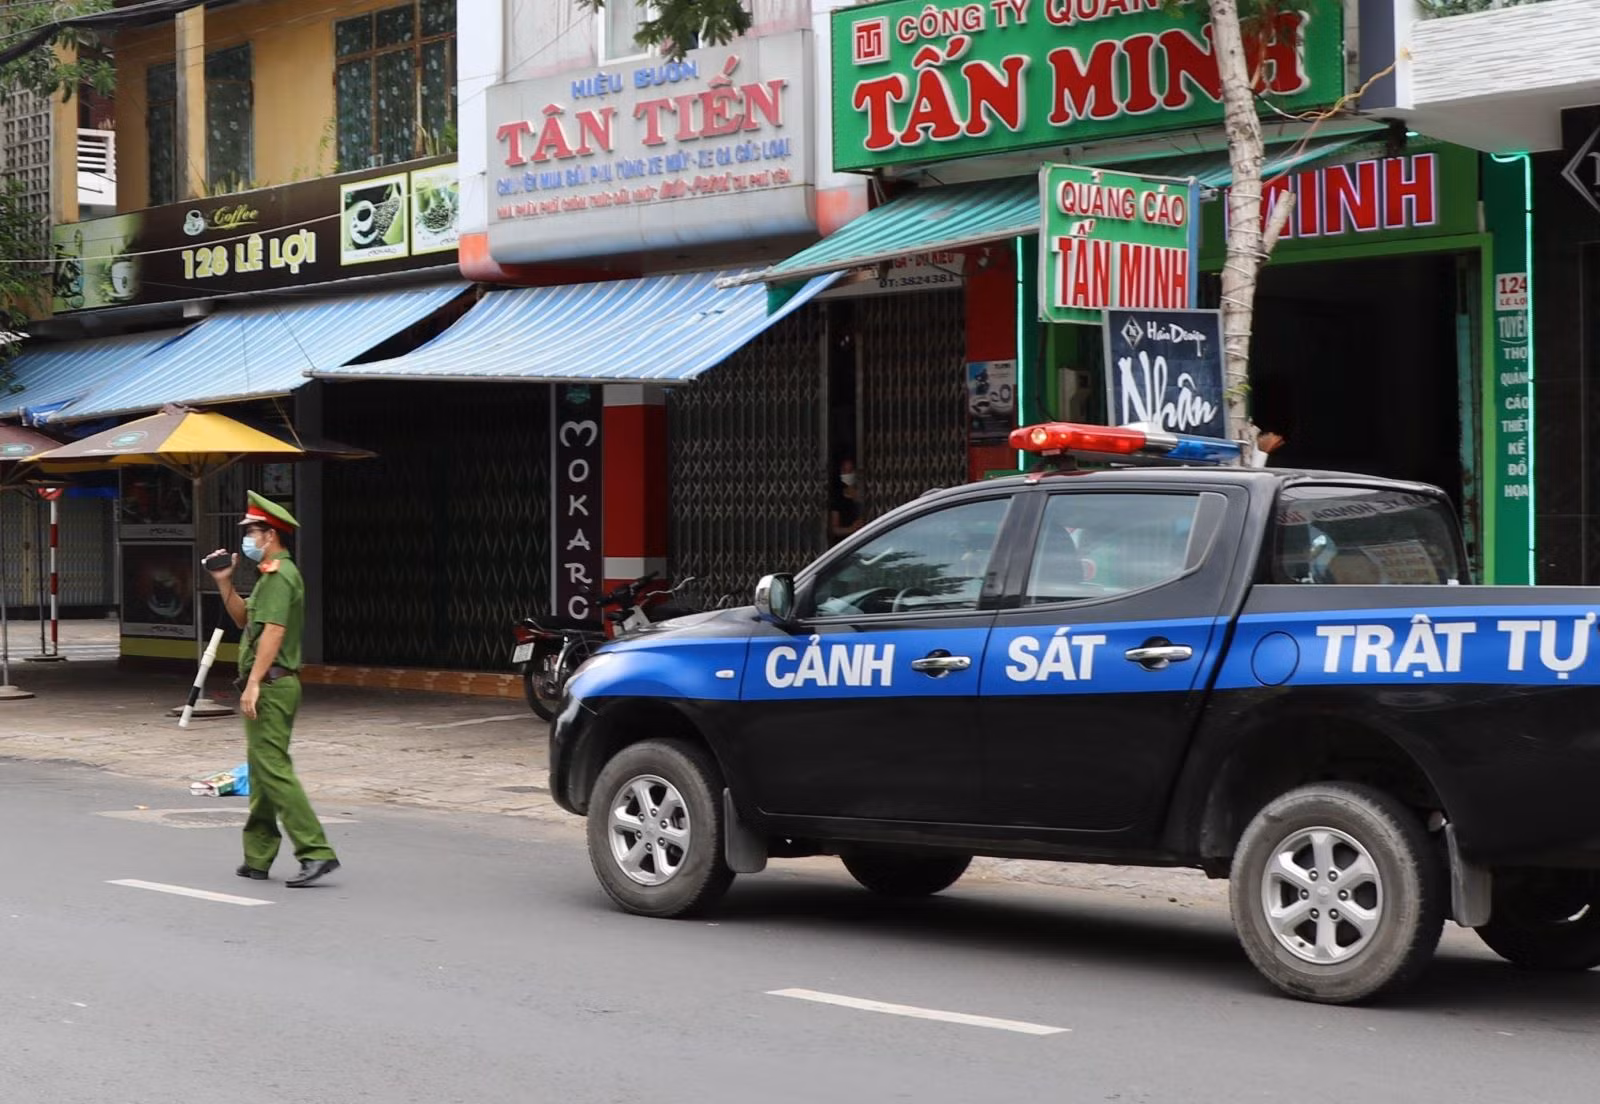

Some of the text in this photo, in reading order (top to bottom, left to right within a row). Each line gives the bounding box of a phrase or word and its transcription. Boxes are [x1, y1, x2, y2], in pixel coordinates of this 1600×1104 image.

[897, 5, 985, 43] CÔNG
[992, 0, 1027, 27] TY
[496, 55, 787, 167] TÂN TIẾN
[853, 35, 1029, 150] TẤN
[213, 204, 259, 228] Coffee
[1057, 170, 1187, 227] QUẢNG CÁO
[182, 229, 316, 279] 128 LÊ LỢI
[1053, 219, 1188, 309] TẤN MINH
[1499, 276, 1527, 294] 124
[1118, 351, 1217, 431] Nhân
[765, 612, 1596, 688] CẢNH SÁT TRẬT TỰ
